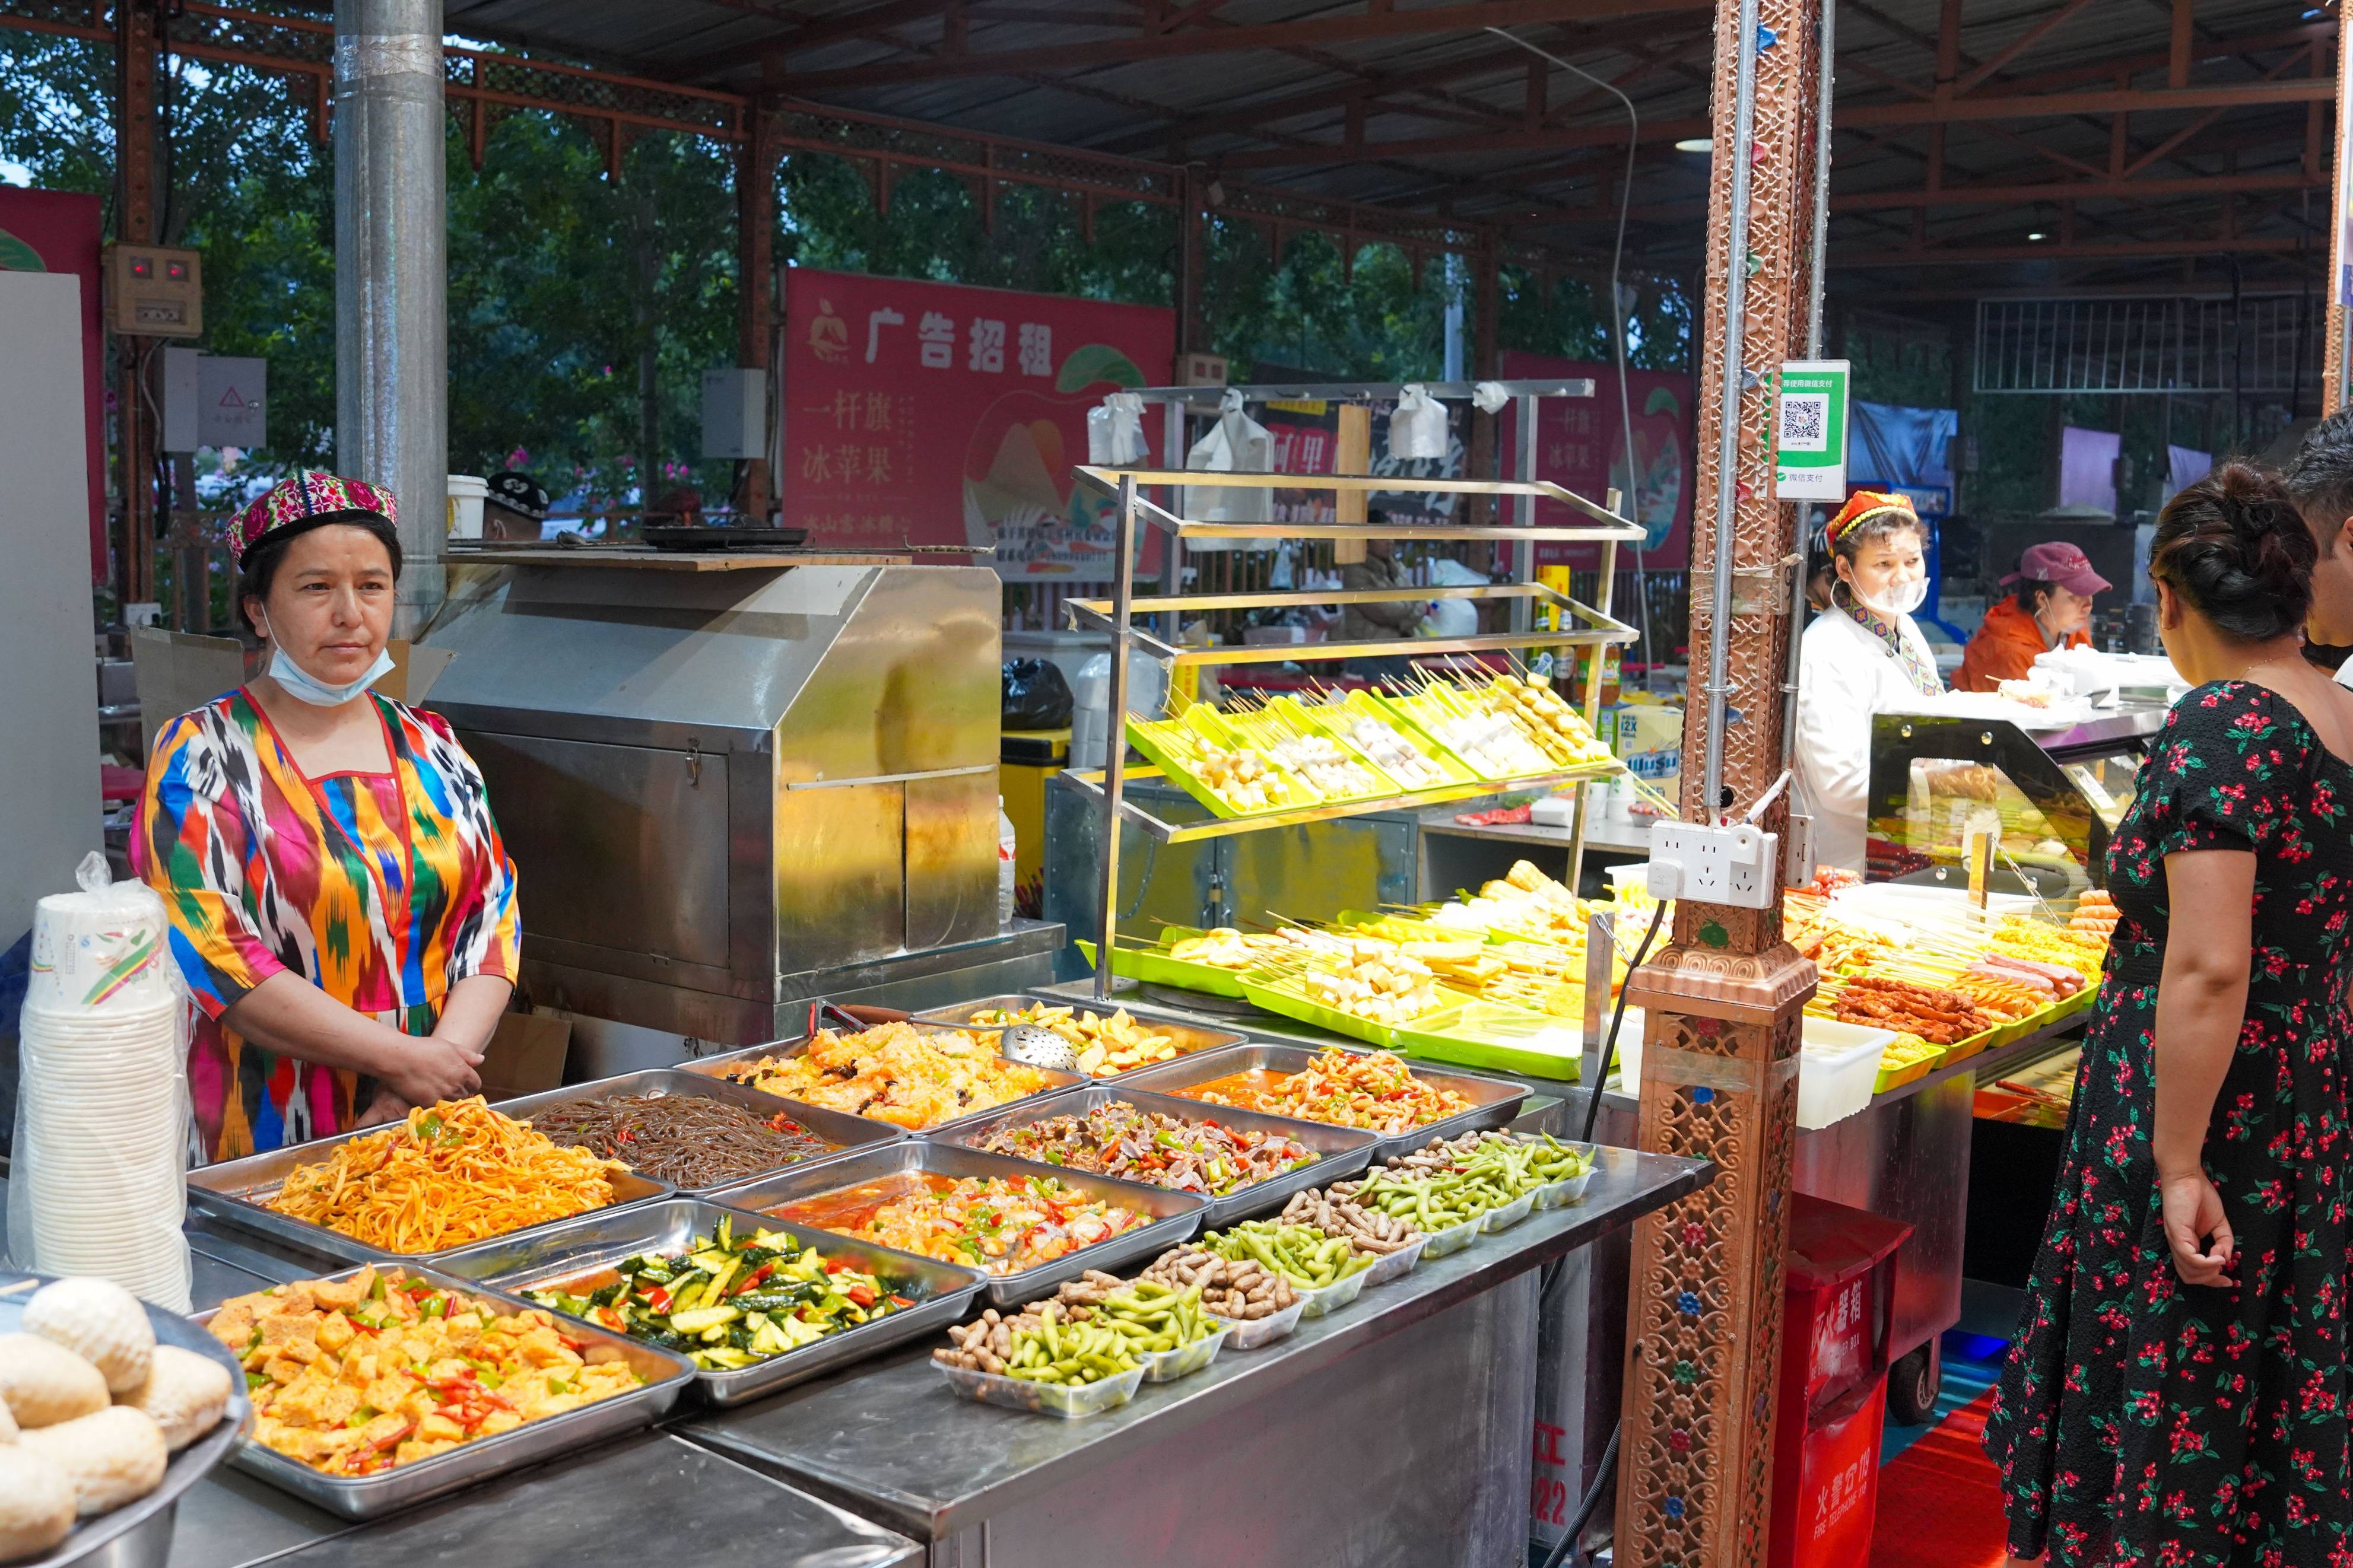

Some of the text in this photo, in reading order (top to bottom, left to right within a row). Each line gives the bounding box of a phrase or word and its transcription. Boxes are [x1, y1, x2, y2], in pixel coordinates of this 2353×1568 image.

[865, 307, 1053, 377] 广告招租
[1781, 379, 1833, 388] 荐使用微信支付
[803, 444, 891, 485] 冰苹果
[1789, 473, 1823, 483] 微信支付
[1811, 1279, 1862, 1353] 灭火器箱
[1850, 1332, 1860, 1350] BOX
[1532, 1477, 1566, 1526] 22
[1816, 1446, 1870, 1521] 火警 119
[1814, 1519, 1827, 1541] FIRE
[1828, 1490, 1857, 1528] TELEPHONE
